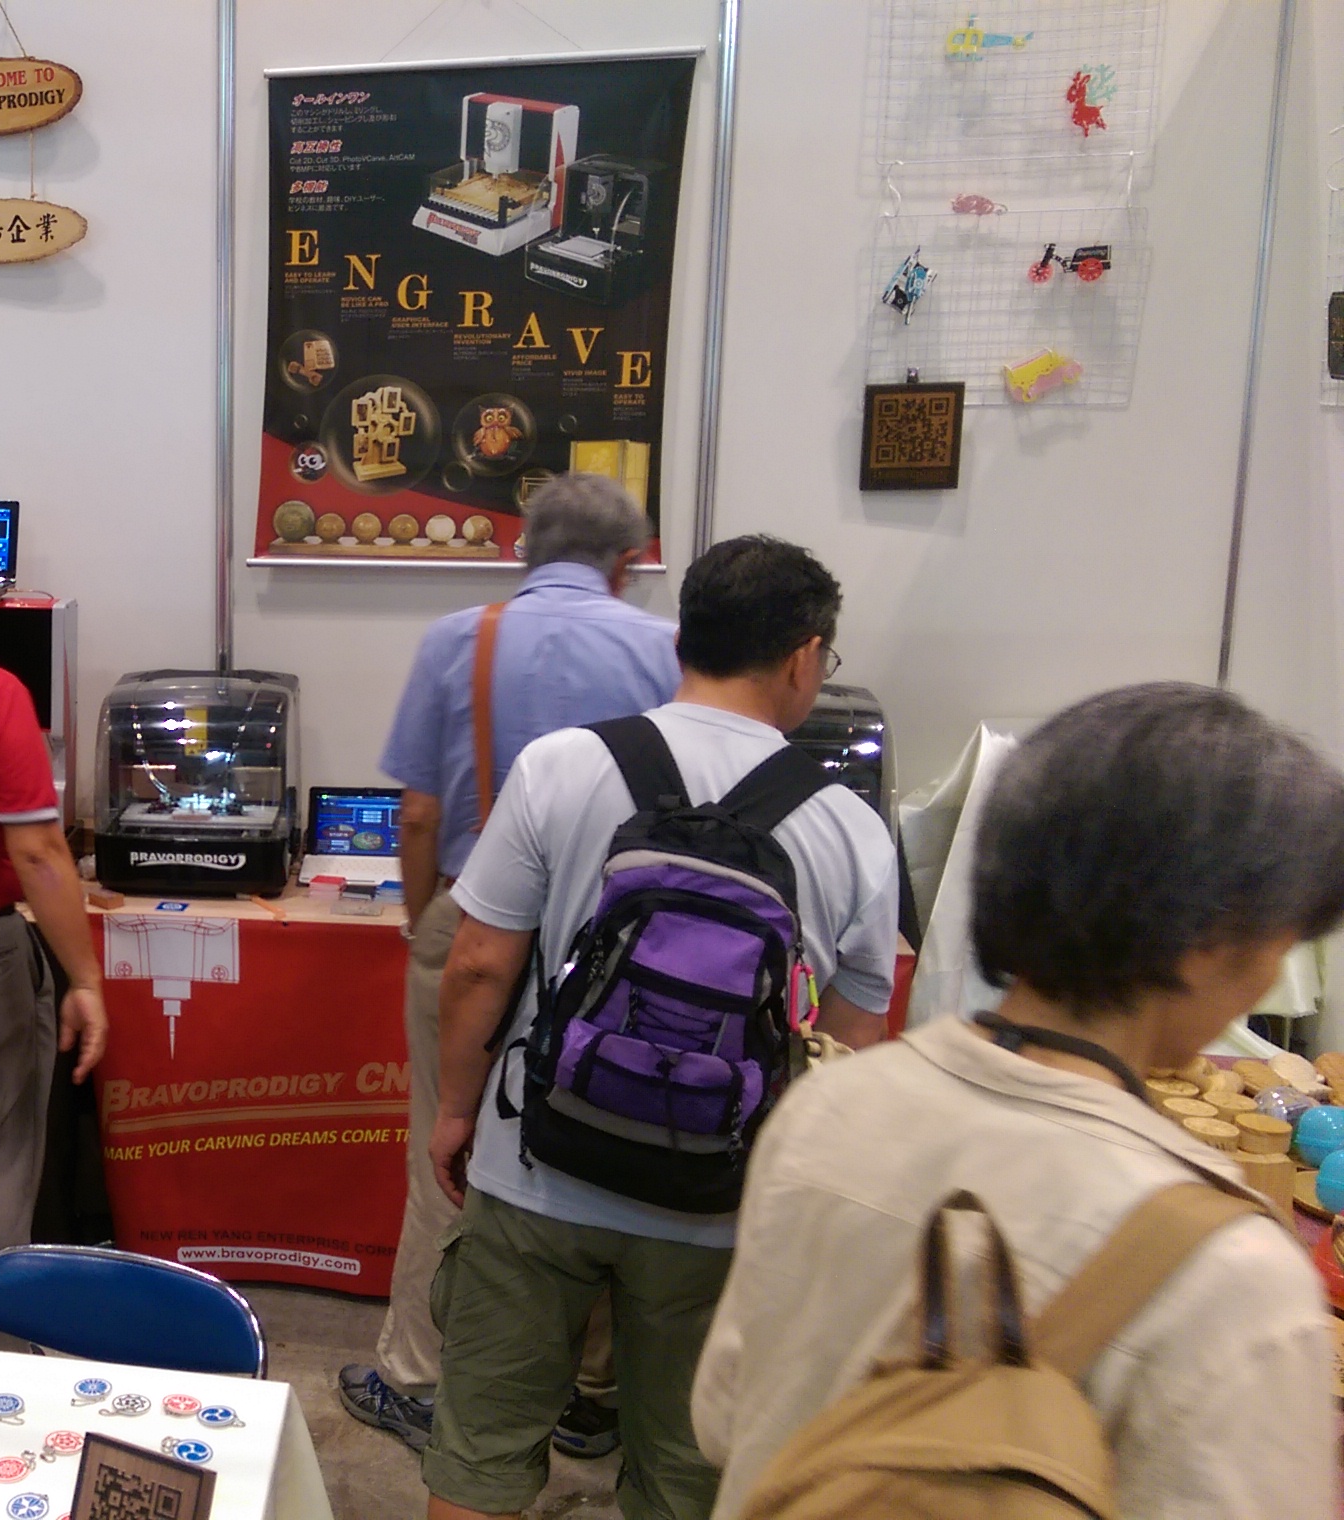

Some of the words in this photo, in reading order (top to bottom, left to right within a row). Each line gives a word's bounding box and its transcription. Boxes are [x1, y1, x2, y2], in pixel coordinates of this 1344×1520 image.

[35, 67, 55, 83] TO
[130, 851, 241, 867] BRAVOPRODIGY
[102, 1072, 345, 1114] BRAVOPRODIGY
[104, 1145, 144, 1160] MAKE
[148, 1140, 190, 1158] YOUR
[195, 1133, 266, 1152] CARVING
[269, 1130, 337, 1146] DREAMS
[341, 1129, 390, 1144] COME
[140, 1230, 173, 1241] NEW
[177, 1231, 207, 1241] REN
[212, 1231, 252, 1242] YANG
[257, 1231, 350, 1252] ENTERPRISE
[181, 1247, 357, 1272] www.bravoprodigy.com
